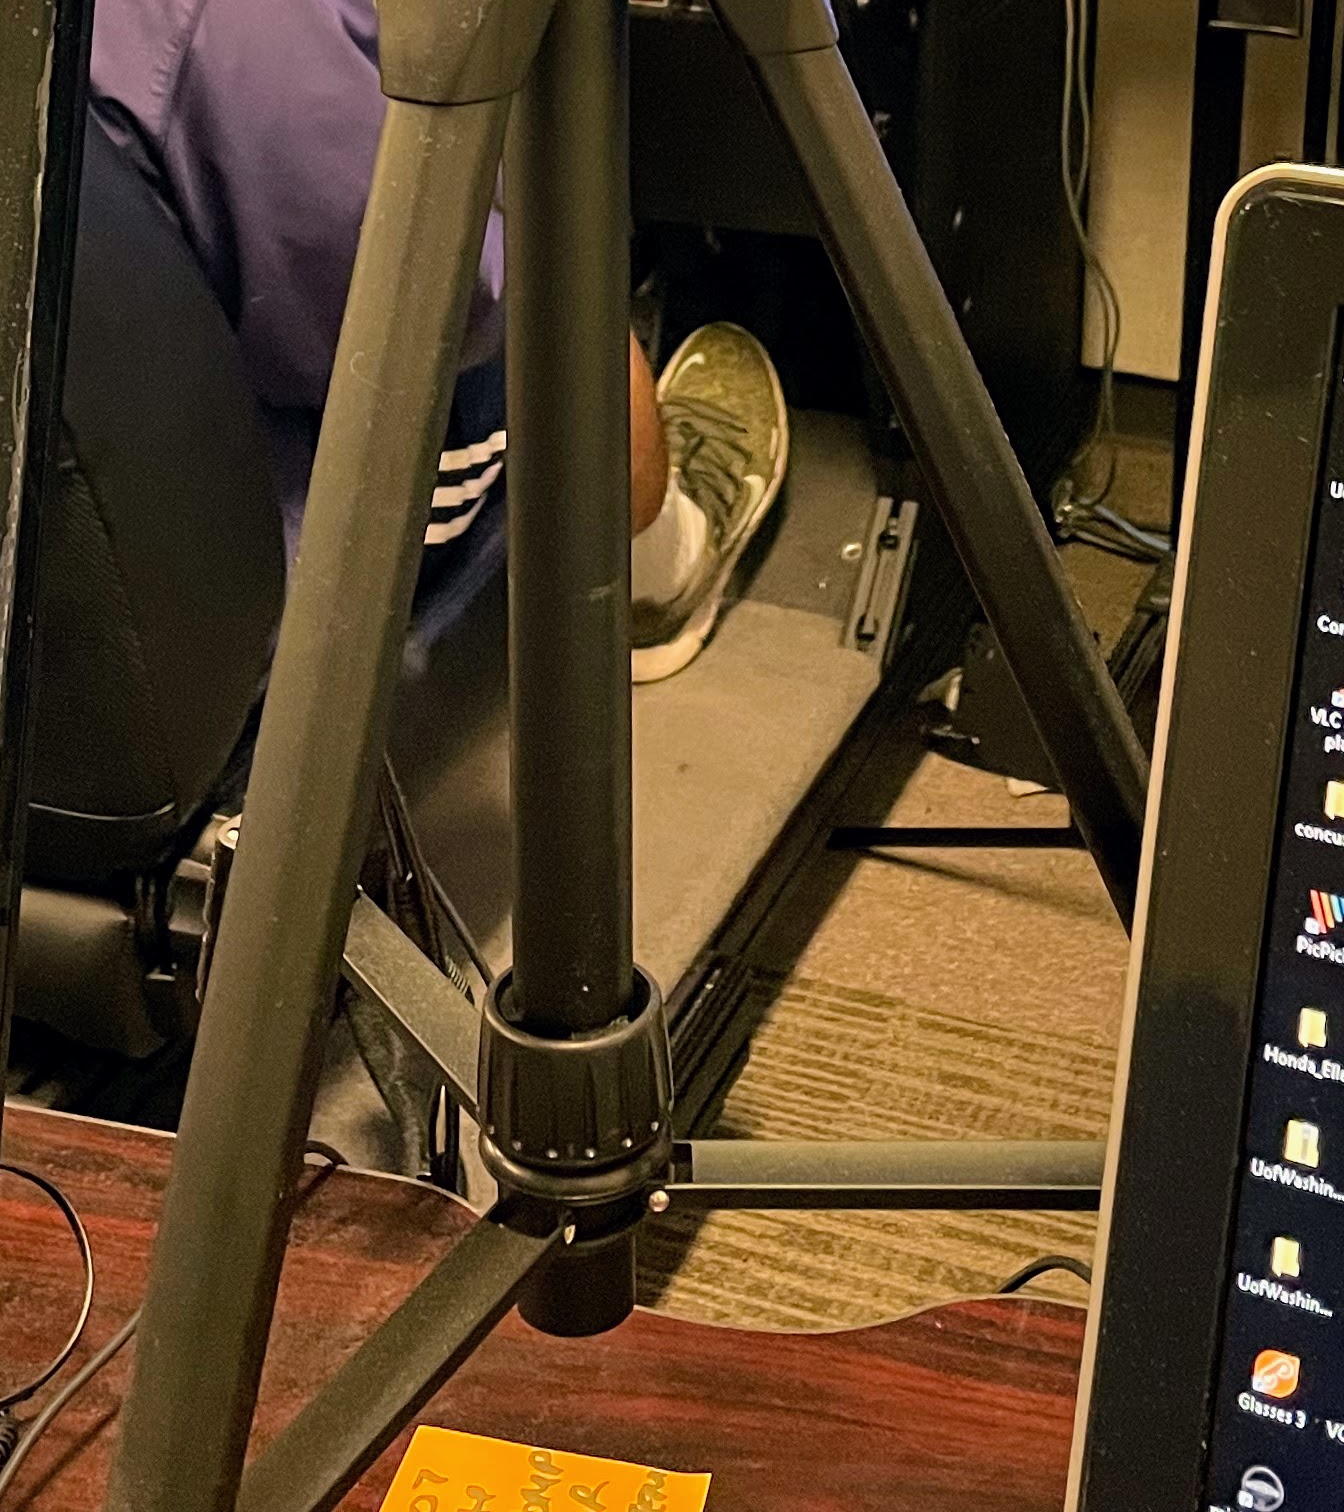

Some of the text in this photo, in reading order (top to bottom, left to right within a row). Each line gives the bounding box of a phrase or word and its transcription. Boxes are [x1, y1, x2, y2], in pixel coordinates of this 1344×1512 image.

[1310, 705, 1342, 730] VLC
[1237, 1391, 1306, 1430] Glasses 3
